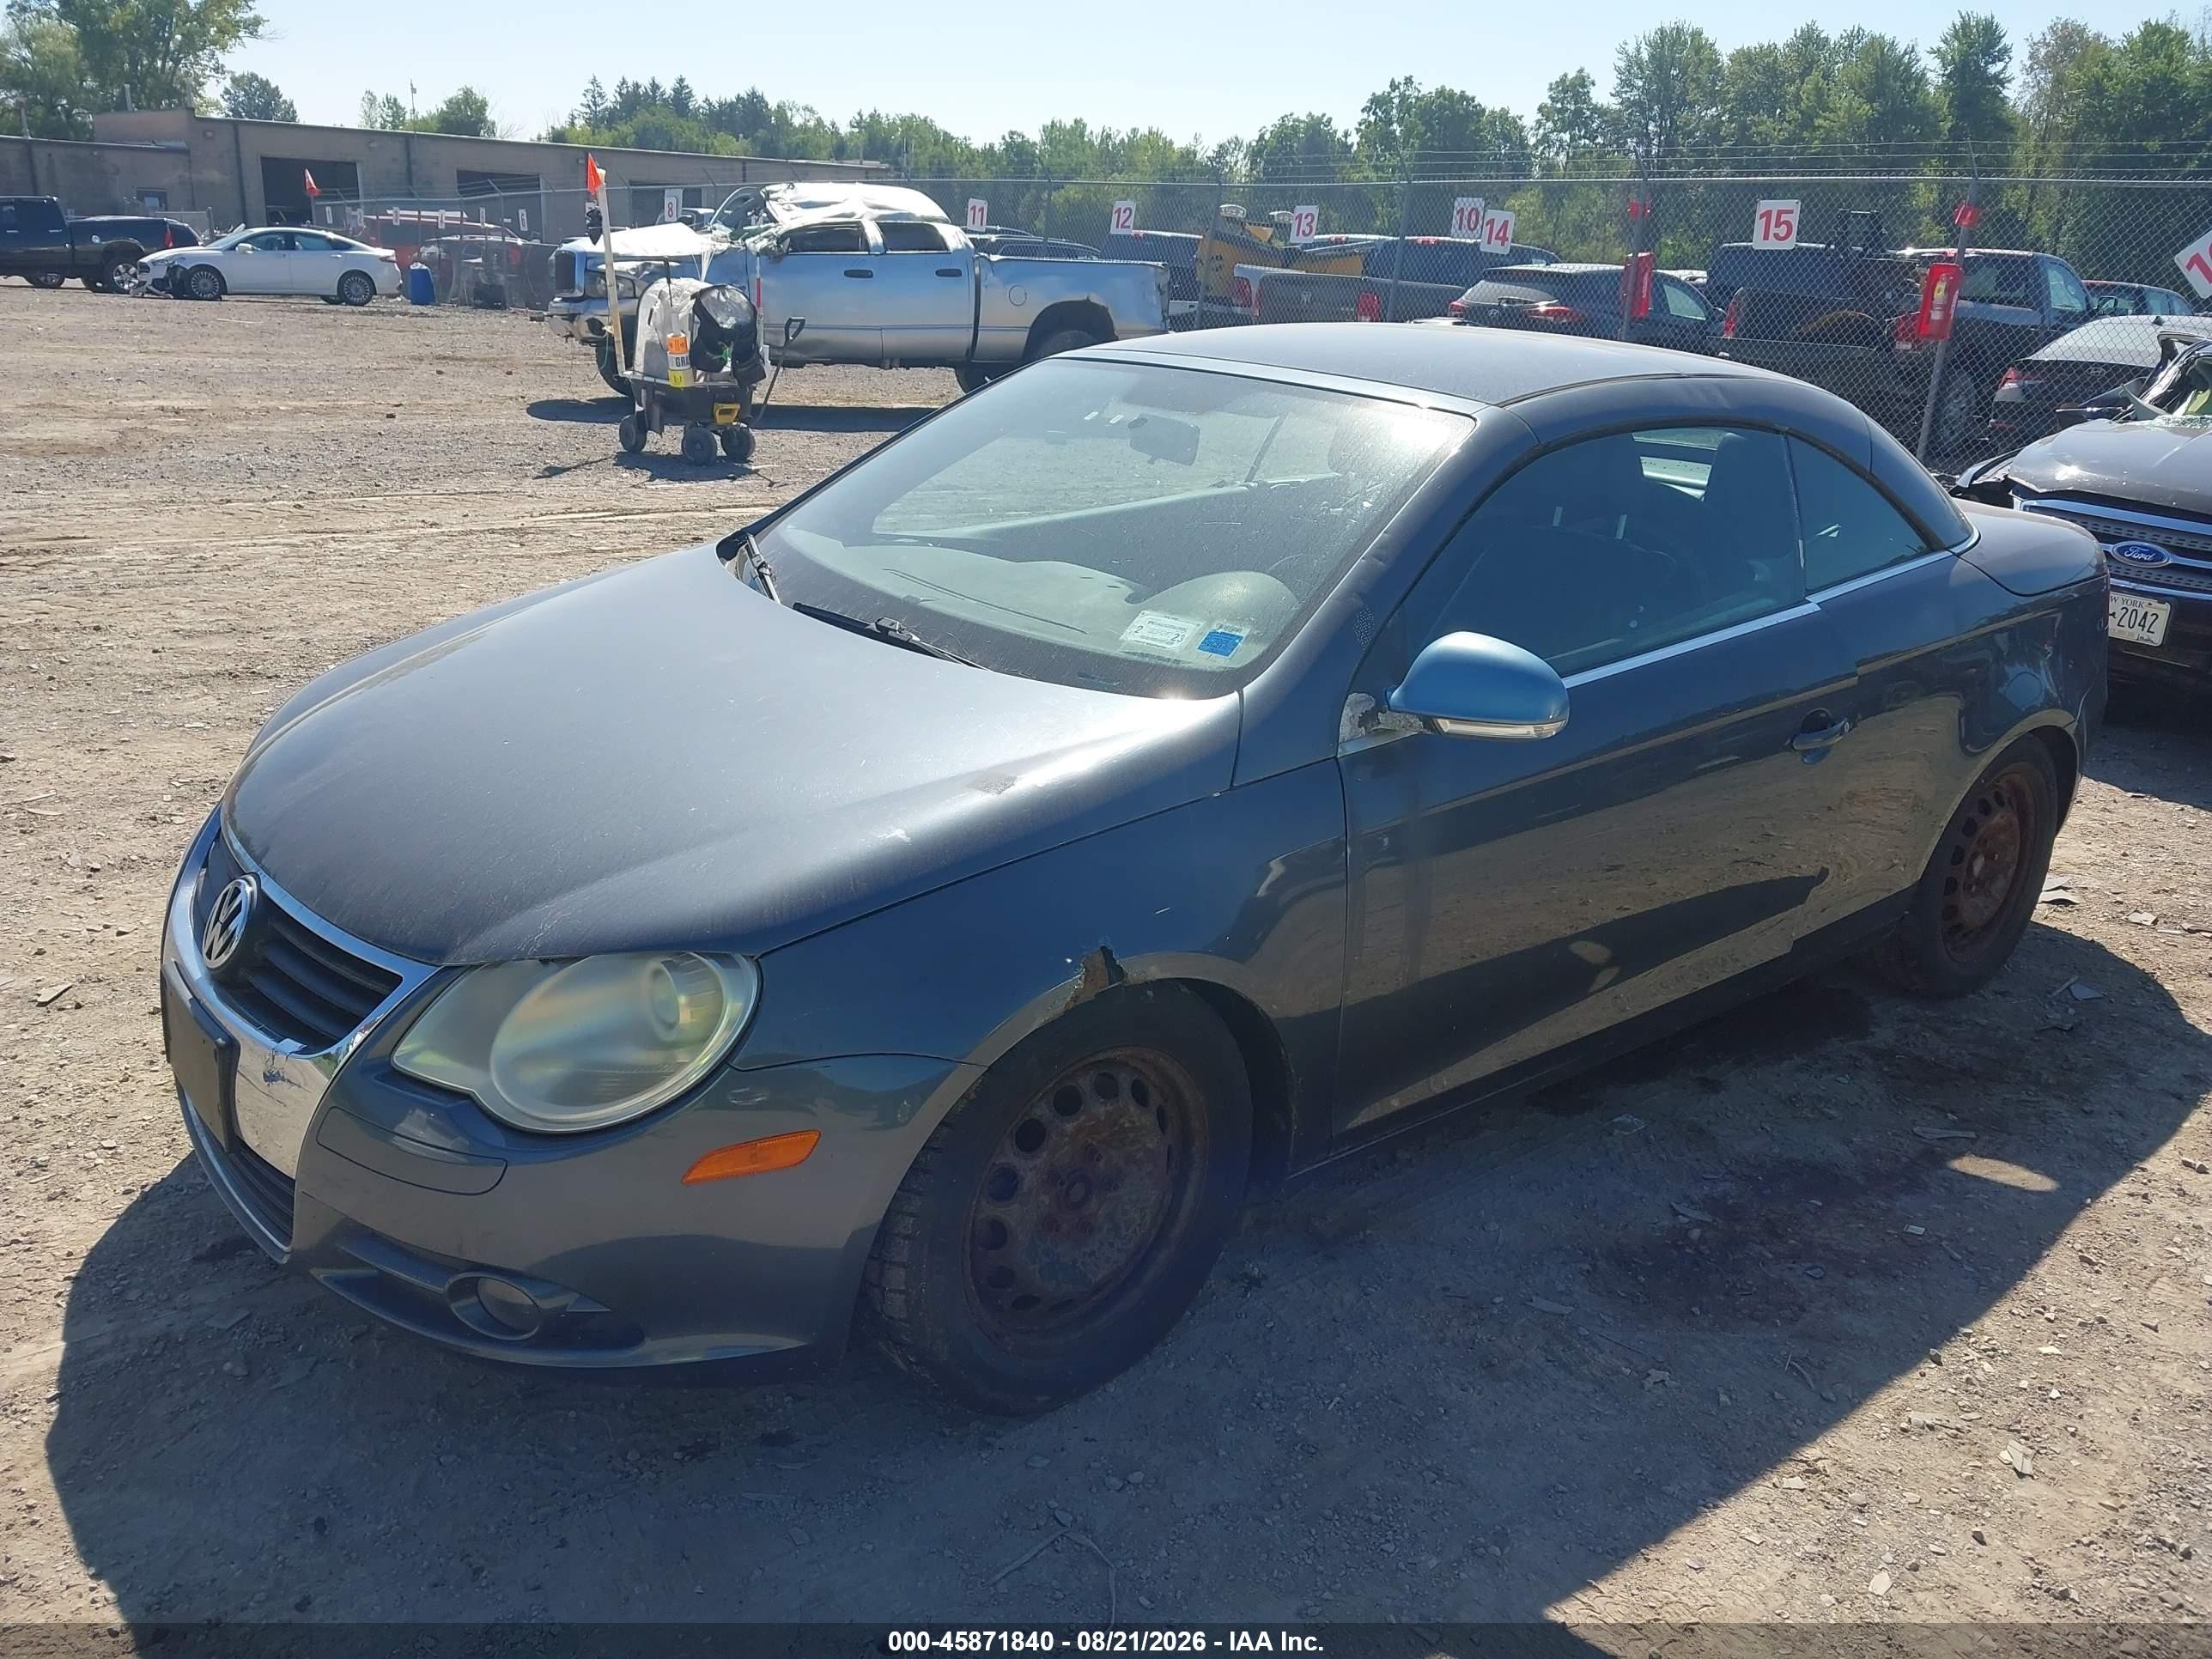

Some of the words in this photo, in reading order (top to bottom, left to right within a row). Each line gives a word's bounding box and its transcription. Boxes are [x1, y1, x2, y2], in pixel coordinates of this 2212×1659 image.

[520, 214, 526, 227] 6
[667, 201, 673, 217] 8
[969, 204, 985, 227] 11
[1115, 207, 1133, 229] 12
[1455, 207, 1480, 232] 10
[1294, 212, 1316, 238] 13
[1486, 218, 1510, 246] 14
[1759, 209, 1795, 241] 15
[2185, 242, 2212, 284] 1
[2124, 546, 2156, 562] Ford
[2121, 597, 2144, 609] YORK
[2117, 606, 2159, 635] 2042
